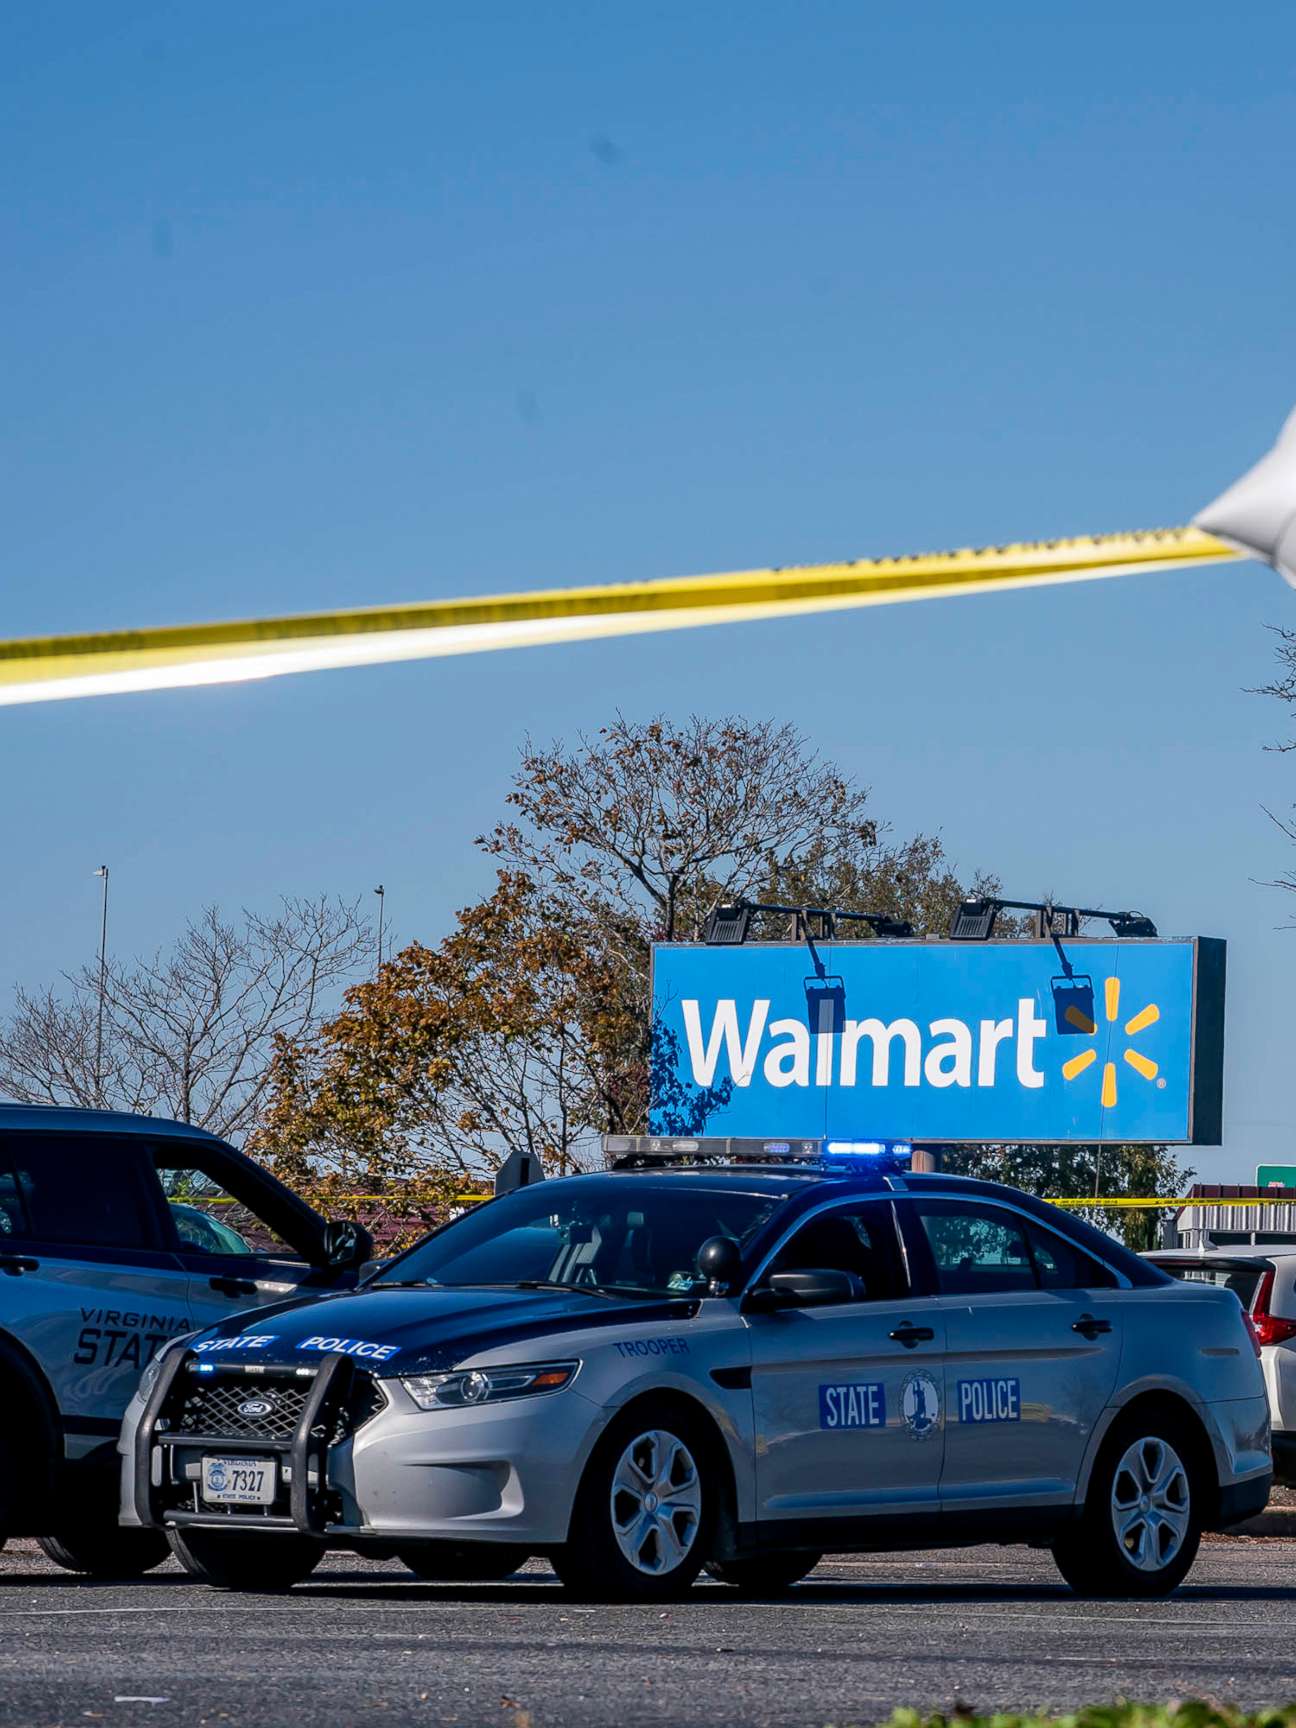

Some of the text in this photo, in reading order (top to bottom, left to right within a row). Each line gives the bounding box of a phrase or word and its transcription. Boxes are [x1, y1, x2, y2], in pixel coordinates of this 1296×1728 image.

[681, 998, 1046, 1088] Walmart
[80, 1307, 191, 1334] VIRGINIA
[73, 1328, 174, 1369] STAT
[195, 1335, 397, 1360] STATE POLICE
[612, 1337, 690, 1359] TROOPER
[825, 1384, 880, 1427] STATE
[961, 1379, 1019, 1422] POLICE
[232, 1470, 264, 1492] 7327
